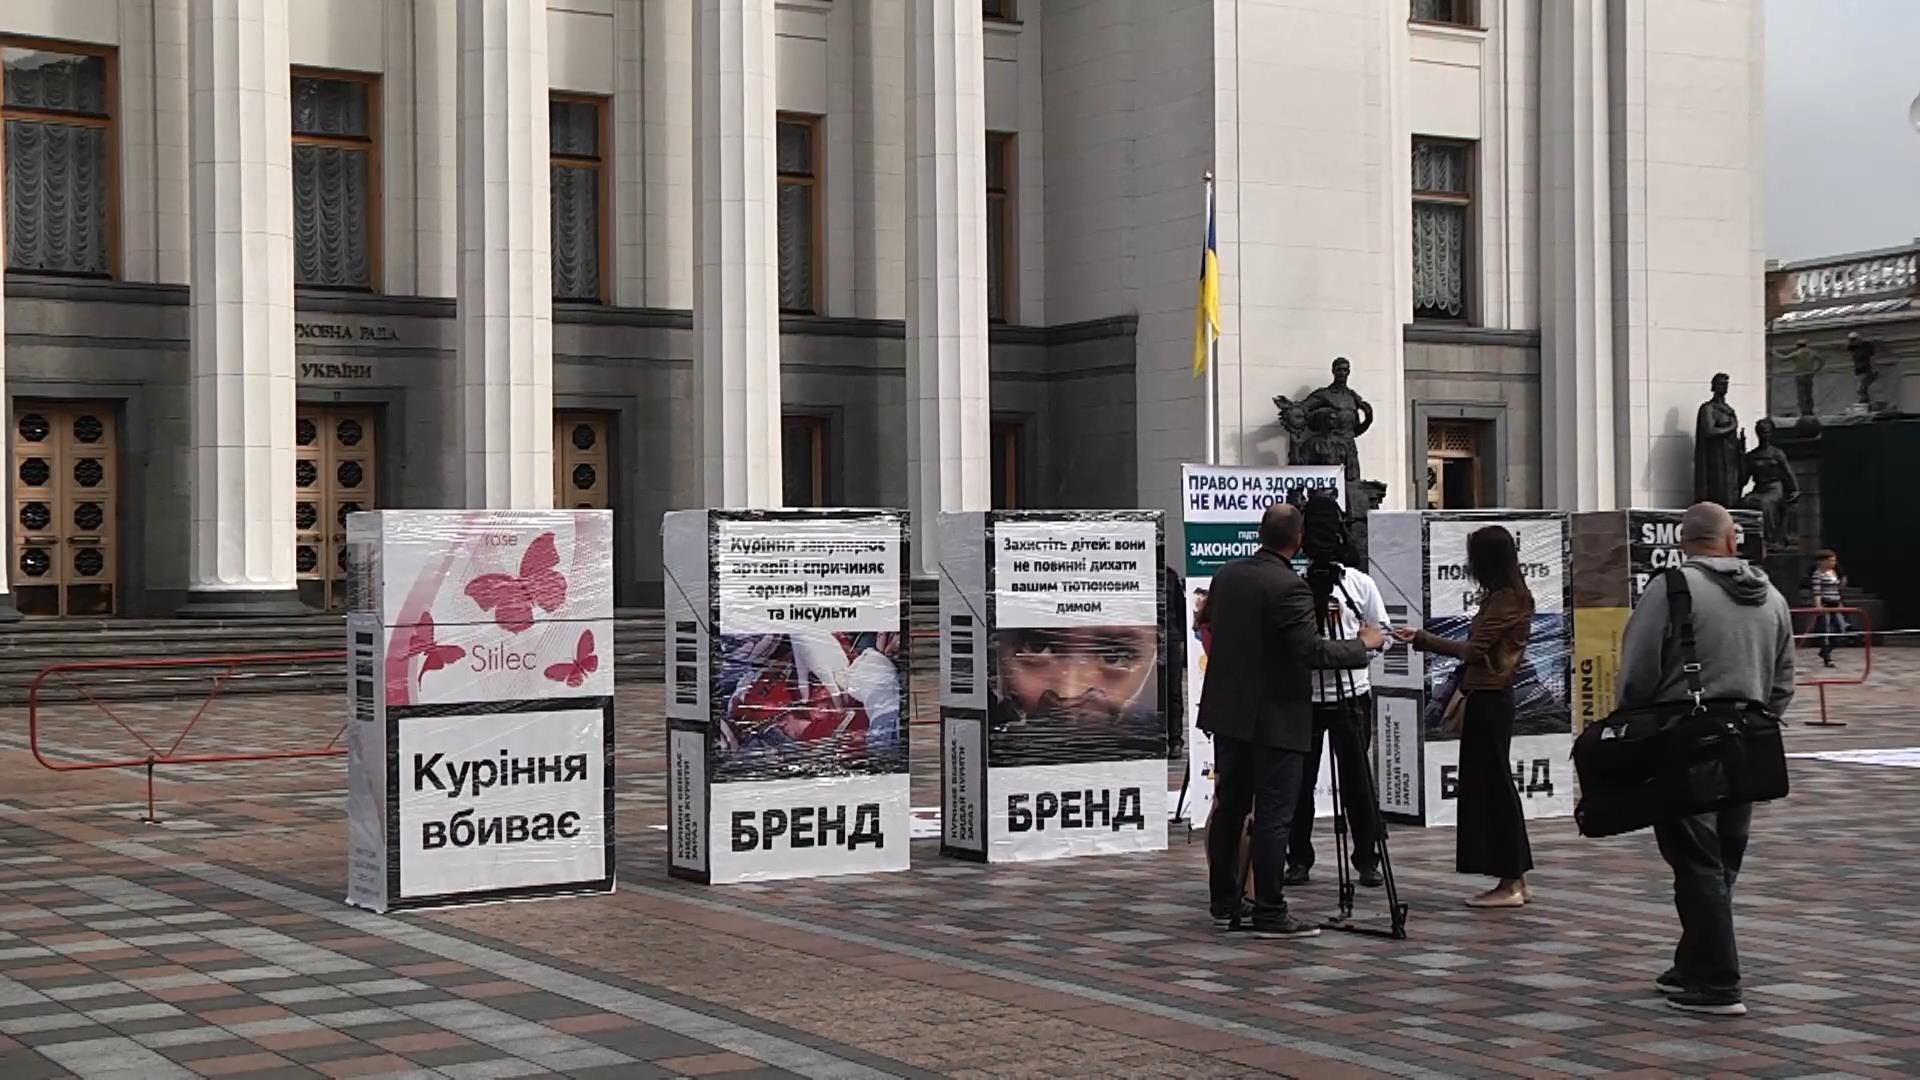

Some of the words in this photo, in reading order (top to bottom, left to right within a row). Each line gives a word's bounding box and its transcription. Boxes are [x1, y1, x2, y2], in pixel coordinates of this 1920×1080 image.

[295, 323, 352, 340] ХОВНА
[359, 326, 400, 341] РАДА
[301, 361, 372, 379] УКРАЇНИ
[1188, 475, 1239, 491] ПРАВО
[1242, 476, 1262, 491] НА
[1190, 494, 1210, 510] НЕ
[1213, 494, 1248, 510] МАЄ
[1252, 494, 1287, 509] КОР
[484, 532, 519, 547] rose
[1642, 522, 1745, 545] SMOG
[730, 537, 796, 555] Куріння
[1003, 536, 1068, 552] Захистіть
[1070, 536, 1111, 552] дітей:
[1114, 540, 1147, 551] вони
[1190, 542, 1264, 557] ЗАКОНОПР
[731, 559, 789, 578] артерії
[802, 560, 886, 578] спричиняє
[1013, 560, 1031, 573] не
[1033, 557, 1087, 573] повинні
[1089, 560, 1138, 573] дихати
[747, 580, 809, 600] серцеві
[813, 584, 871, 599] напади
[1010, 581, 1059, 593] вашим
[1061, 580, 1141, 593] тютюновим
[767, 607, 785, 621] та
[789, 603, 857, 623] інсульти
[1055, 601, 1103, 615] димом
[1580, 658, 1595, 718] NING
[413, 750, 589, 799] Куріння
[1440, 758, 1554, 800] БНД
[1007, 786, 1145, 834] БРЕНД
[421, 806, 583, 851] вбиває
[730, 801, 885, 853] БРЕНД
